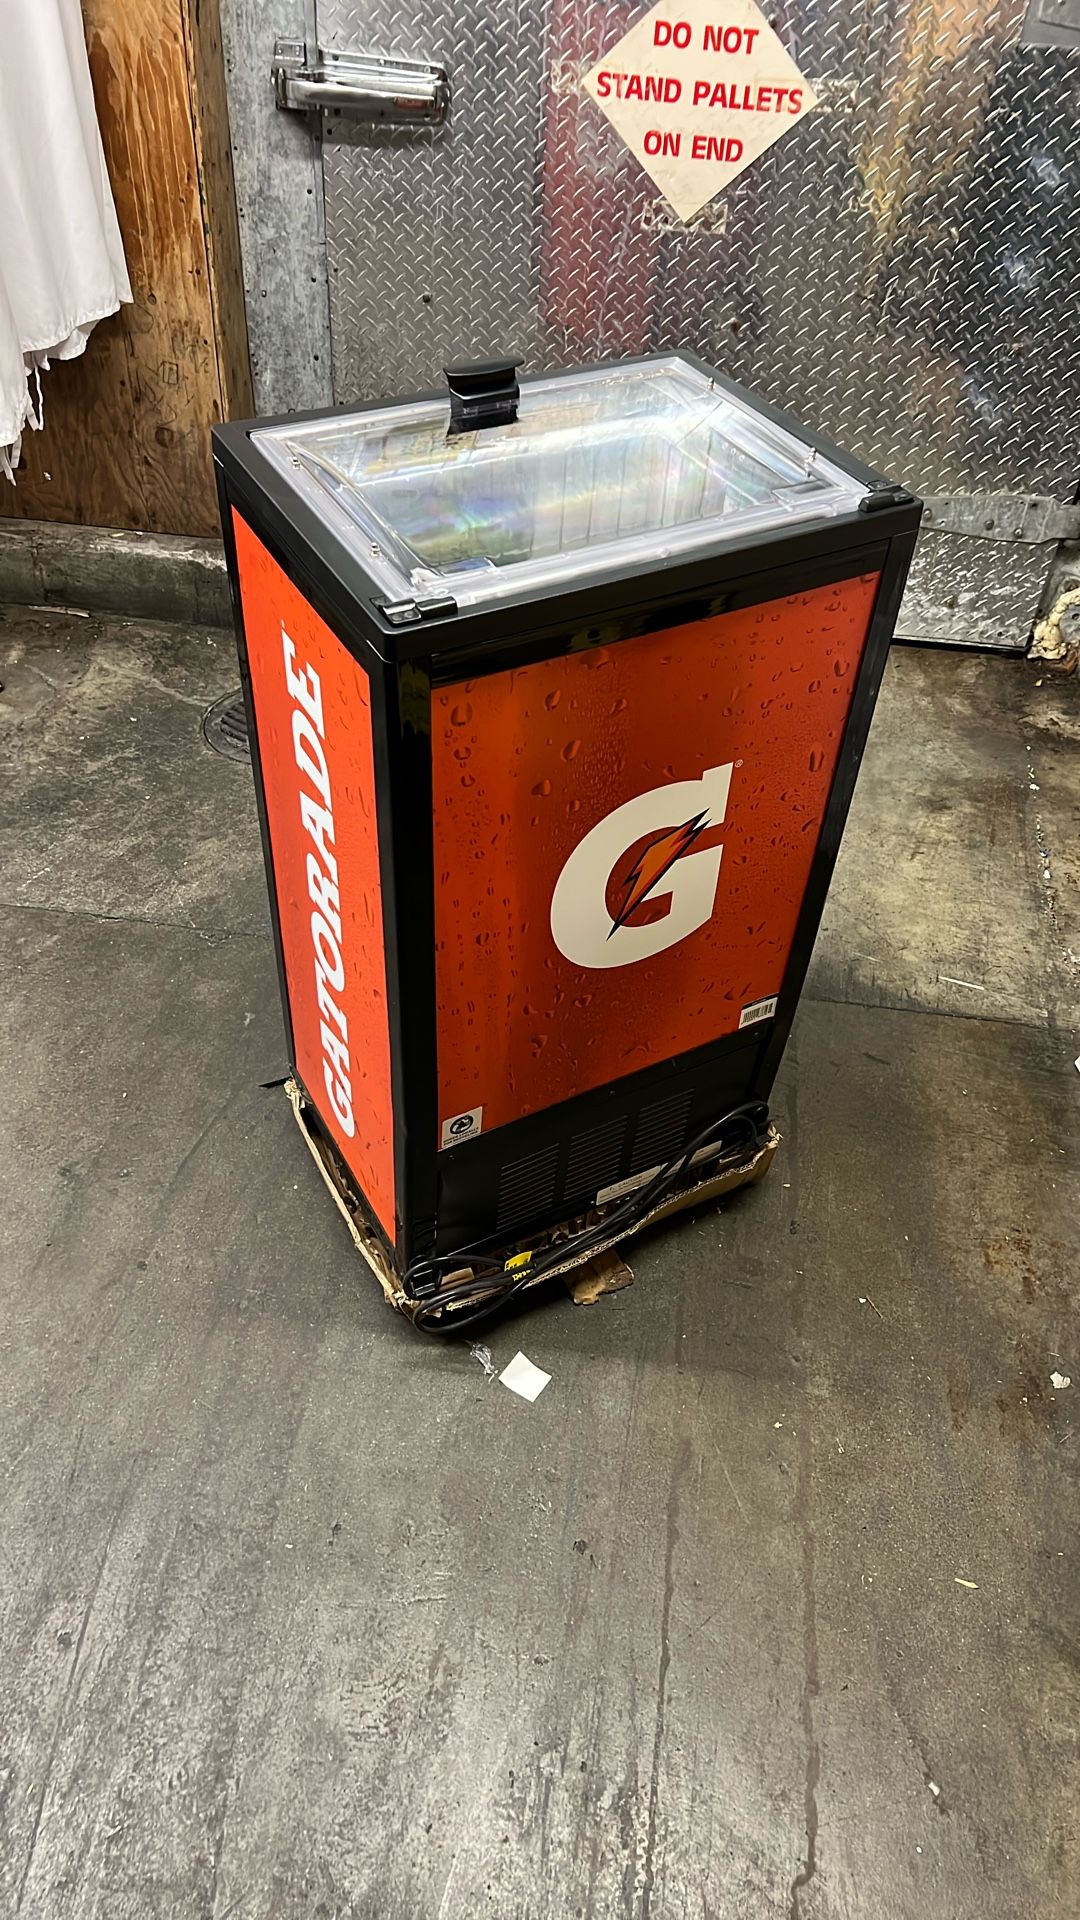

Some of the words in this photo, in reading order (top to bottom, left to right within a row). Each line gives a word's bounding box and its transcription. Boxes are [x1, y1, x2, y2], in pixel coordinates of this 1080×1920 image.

[653, 20, 692, 49] DO
[703, 24, 759, 55] NOT
[597, 71, 682, 104] STAND
[692, 81, 804, 115] PALLETS
[643, 129, 681, 158] ON
[691, 135, 744, 163] END
[281, 628, 355, 1139] GATORADE
[550, 762, 734, 969] G
